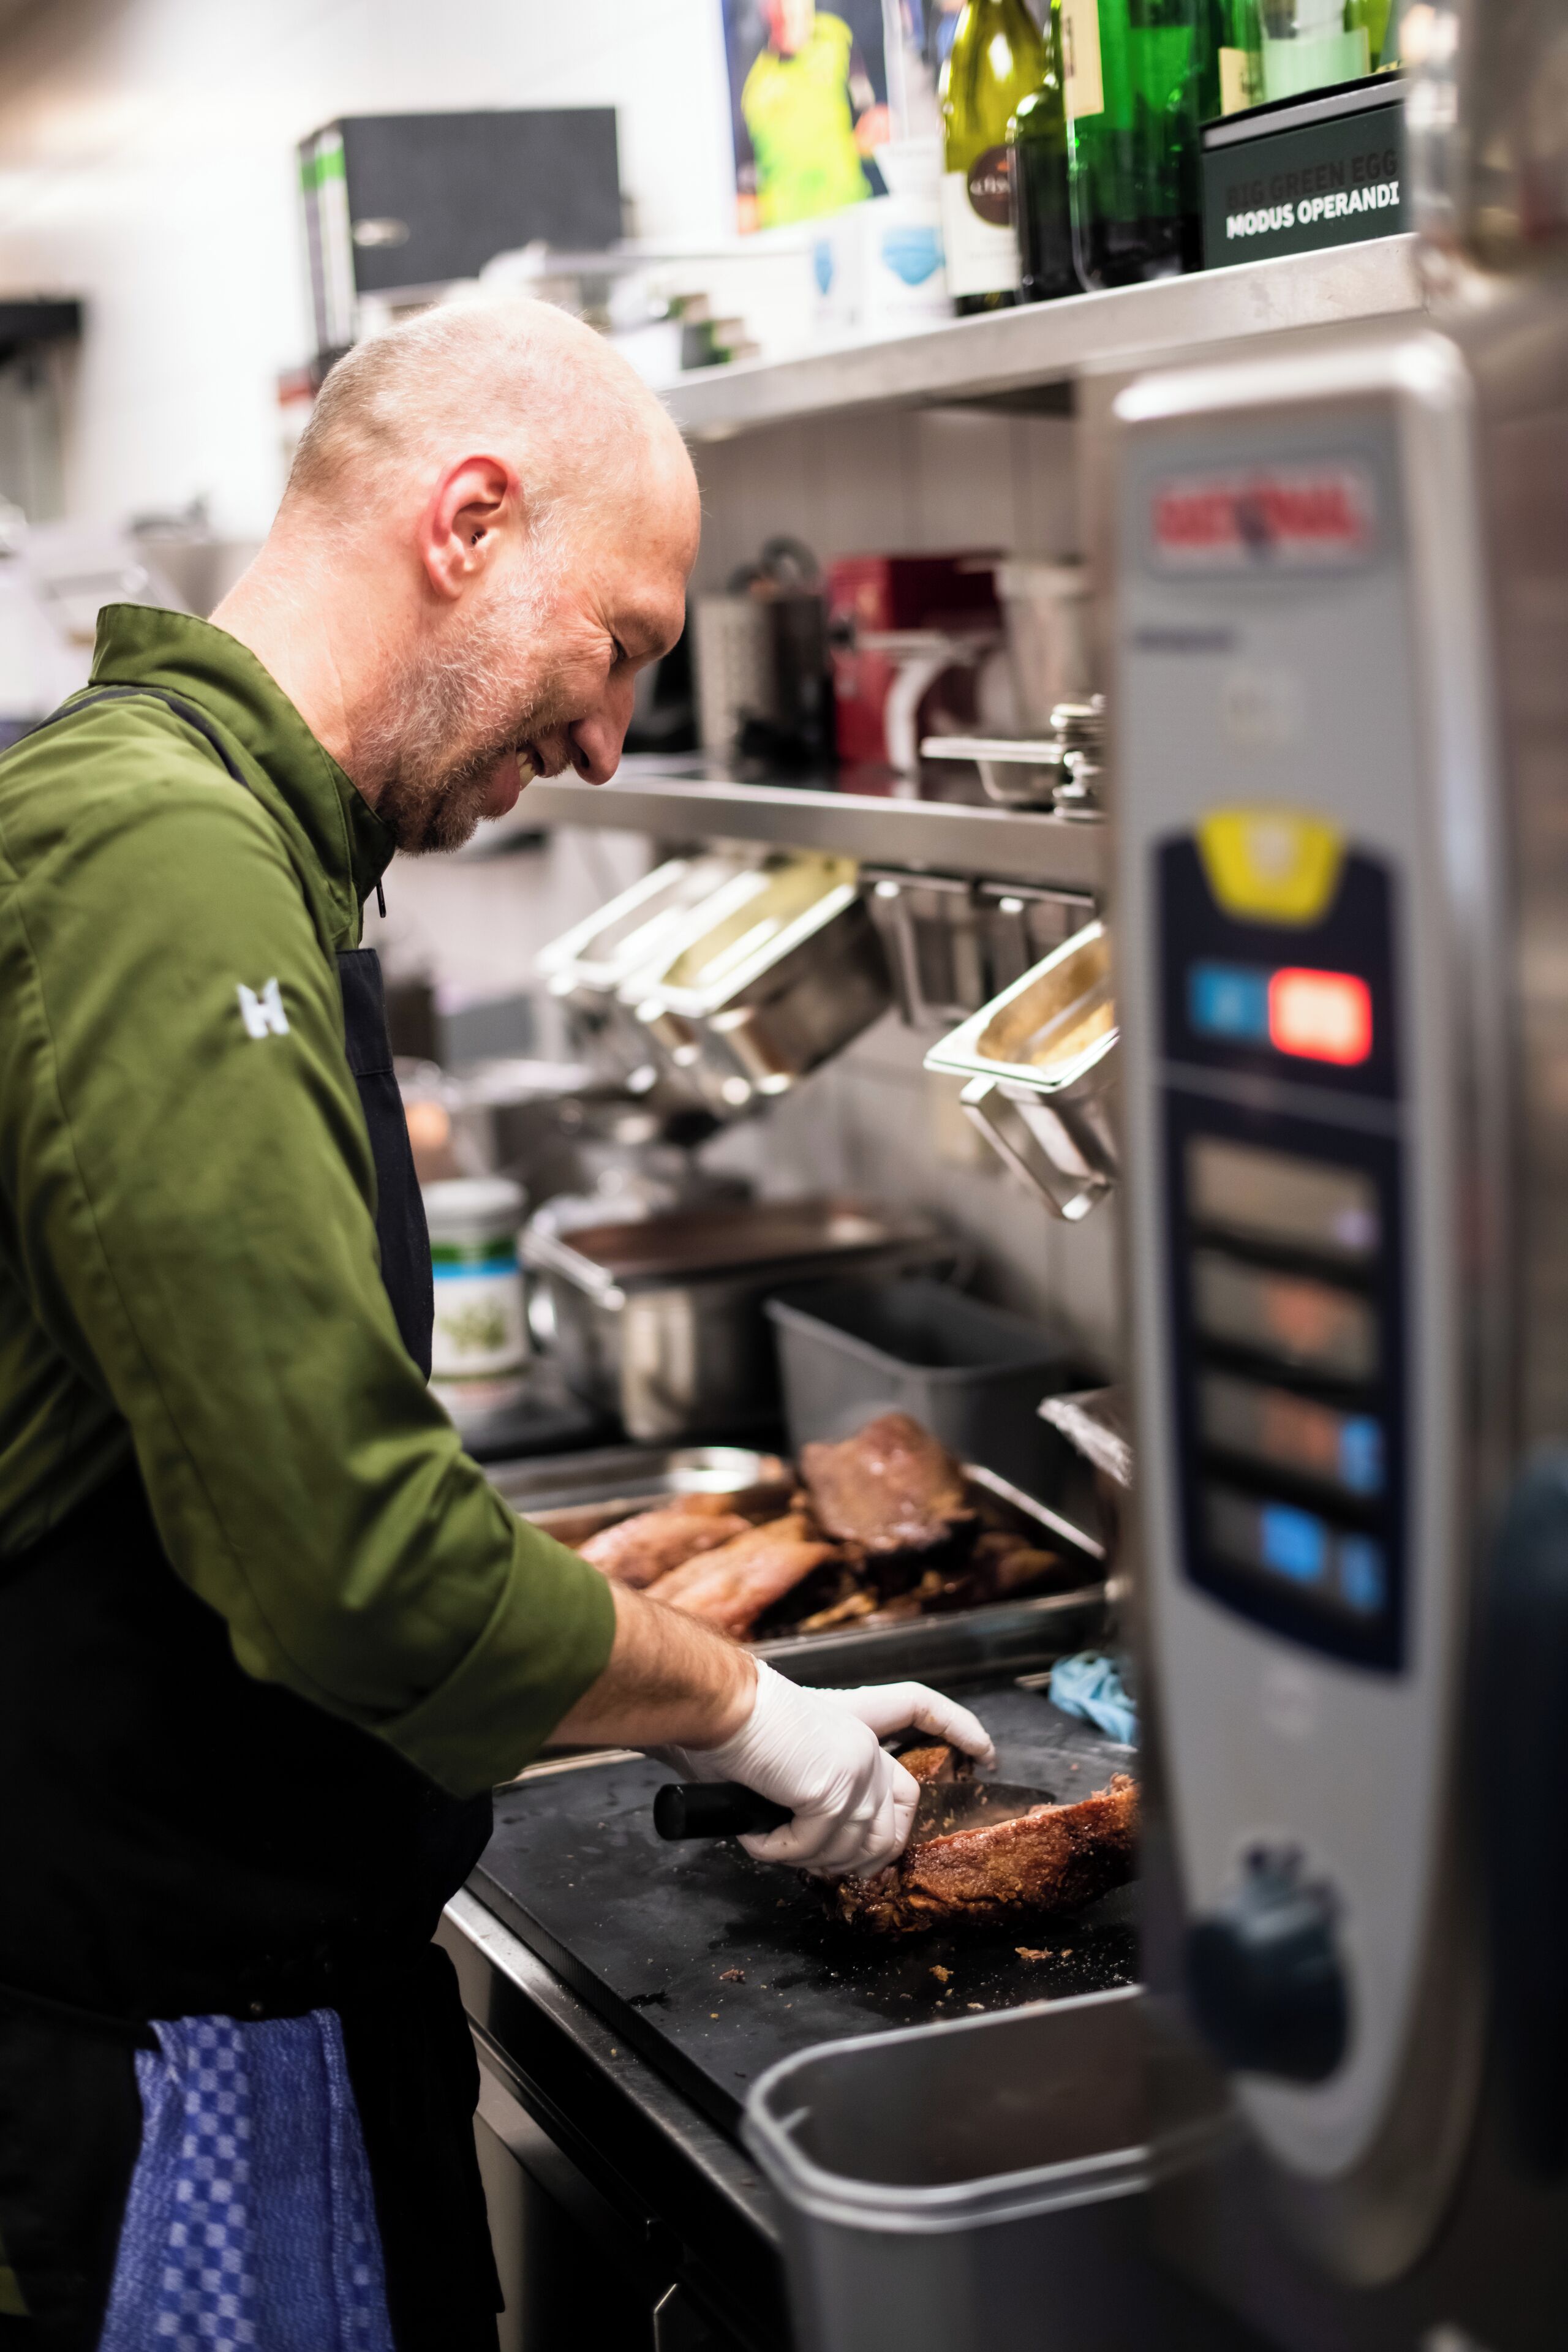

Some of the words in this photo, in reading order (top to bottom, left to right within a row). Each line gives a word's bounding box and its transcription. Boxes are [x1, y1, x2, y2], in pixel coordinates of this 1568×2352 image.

[1227, 180, 1264, 209] BIG
[1270, 162, 1344, 198] GREEN
[1352, 149, 1398, 183] EGG
[1226, 203, 1295, 239] MODUS
[1297, 181, 1400, 224] OPERANDI
